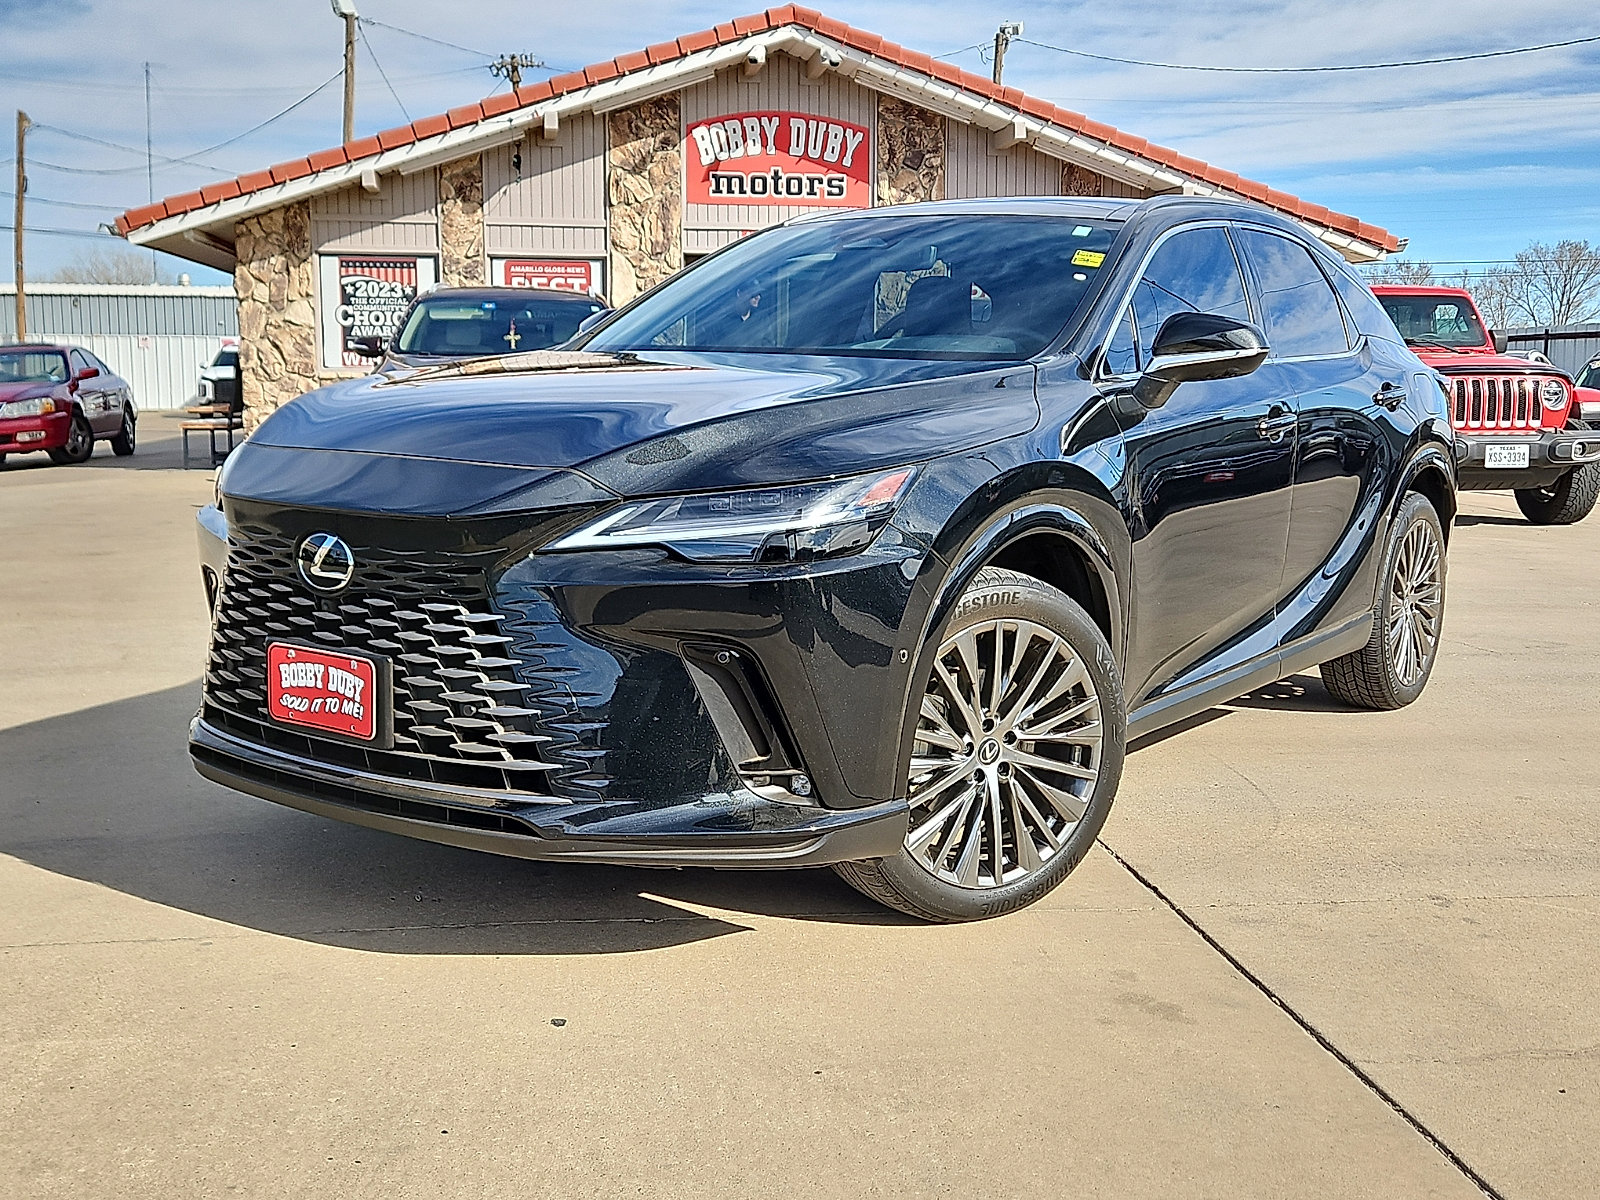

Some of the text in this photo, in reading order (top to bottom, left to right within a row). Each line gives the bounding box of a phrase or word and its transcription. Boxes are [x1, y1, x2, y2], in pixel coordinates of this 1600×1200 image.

[691, 116, 864, 168] BOBBY DUBY
[711, 168, 846, 198] motors
[350, 297, 409, 305] THE OFFICIAL
[355, 281, 404, 298] 2023
[335, 304, 404, 327] CHOIC
[279, 662, 365, 702] BOBBY DUBY
[280, 693, 364, 721] SOLD IT TO ME!
